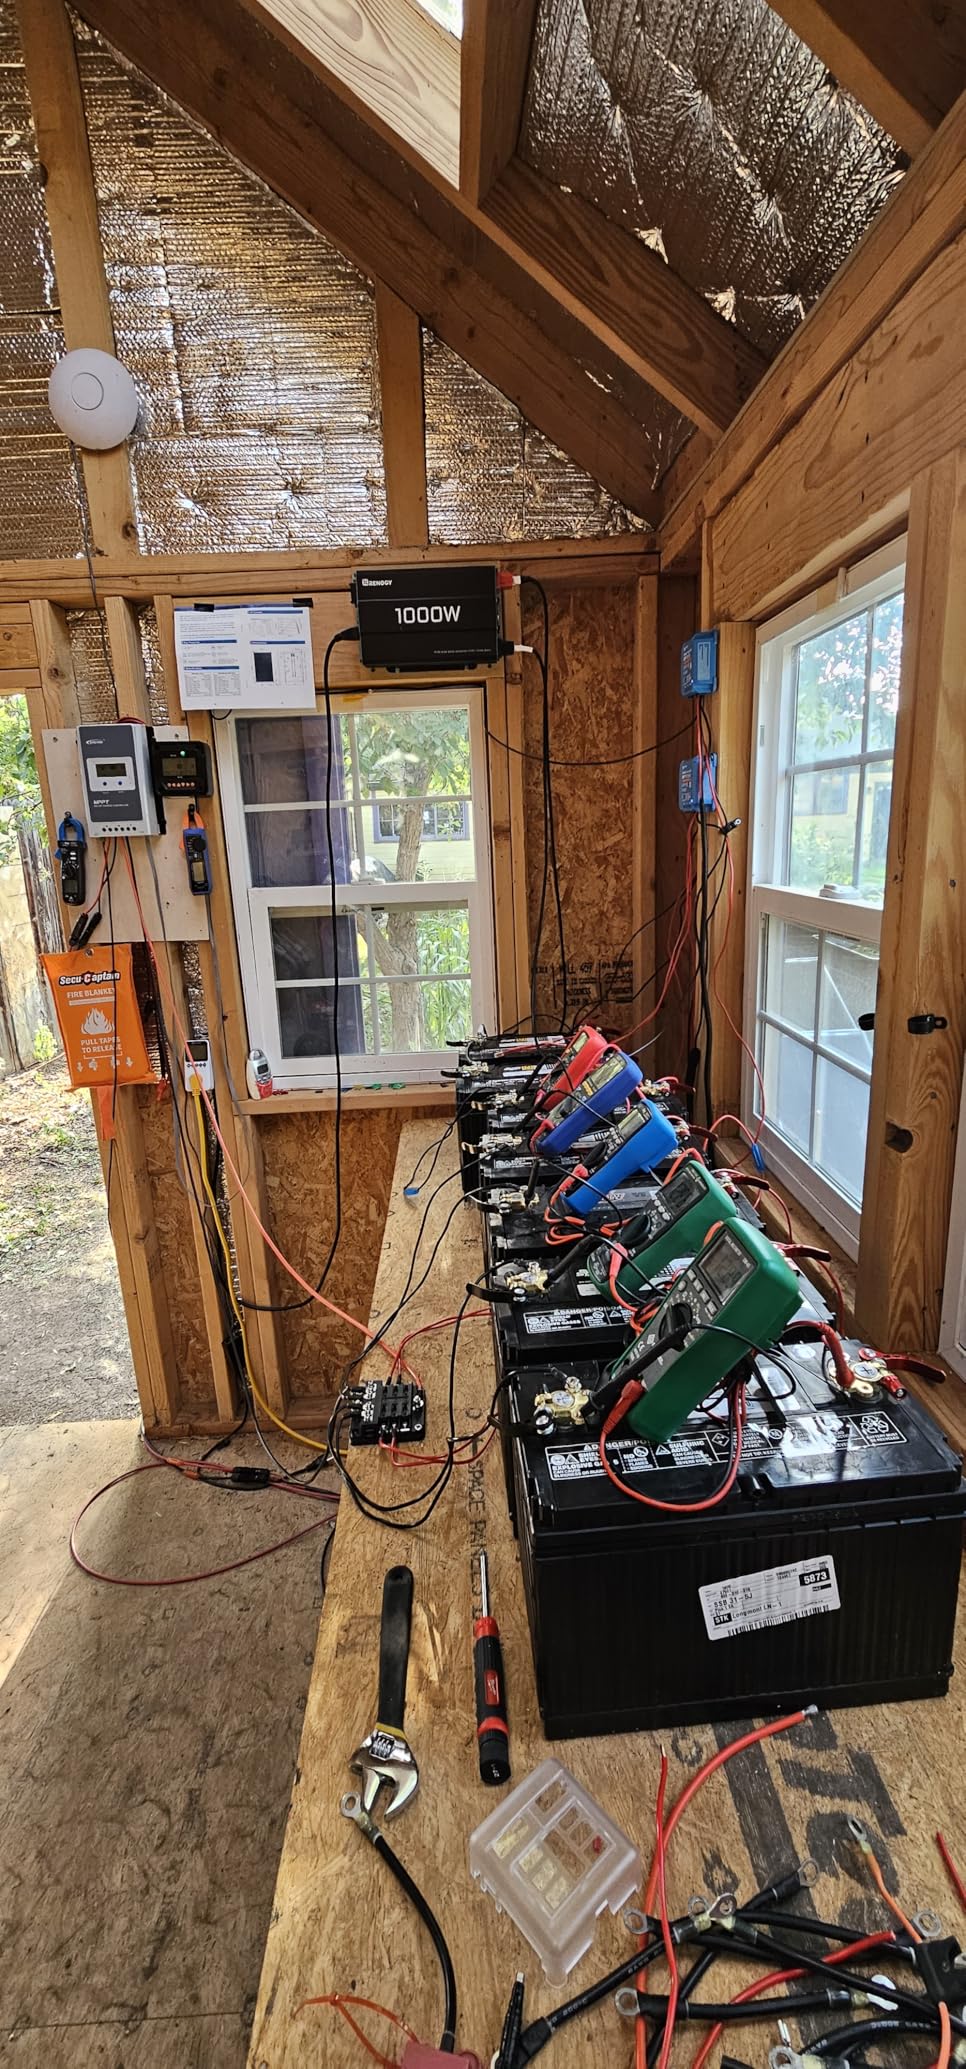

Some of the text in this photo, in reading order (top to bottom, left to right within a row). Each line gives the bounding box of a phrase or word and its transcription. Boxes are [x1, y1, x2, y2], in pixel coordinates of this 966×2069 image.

[394, 605, 461, 624] 1000W
[67, 991, 83, 999] FIRE
[92, 1044, 122, 1053] RELEAE
[552, 1462, 593, 1471] EXPLOSIVE
[468, 1461, 486, 1513] SPACE
[804, 1571, 828, 1584] 5873
[714, 1614, 730, 1624] STK
[732, 1606, 763, 1619] Longmont
